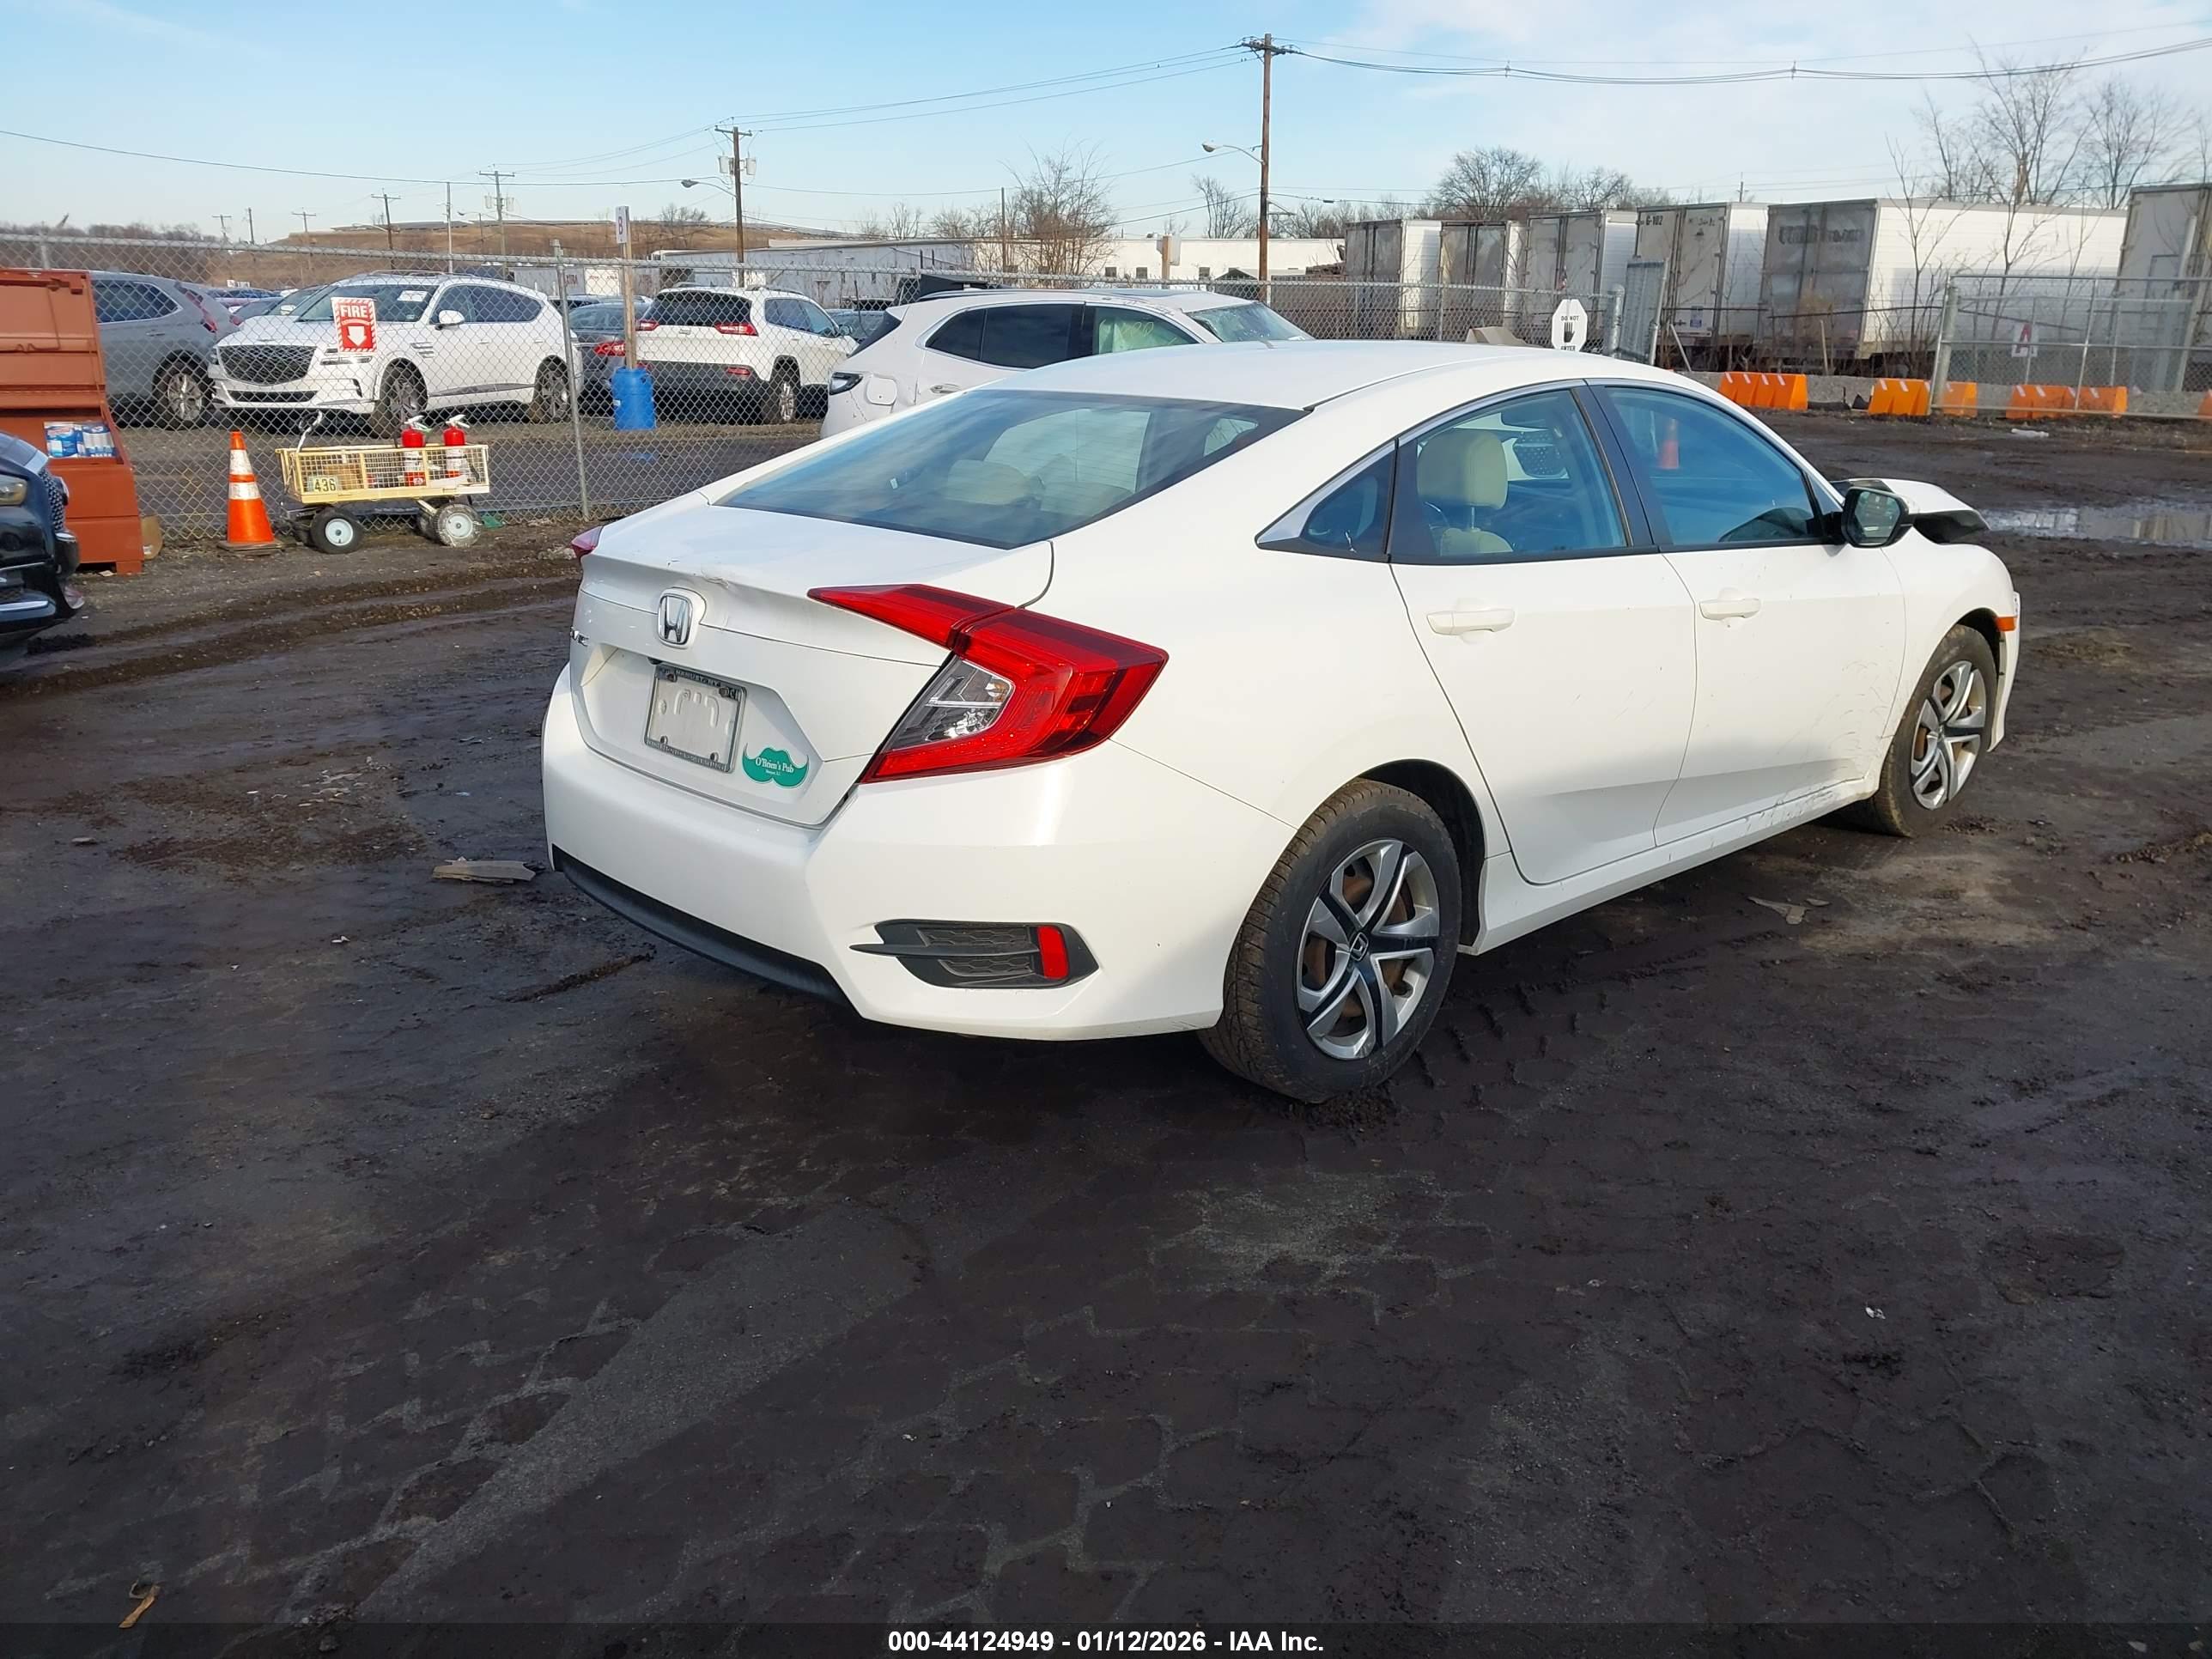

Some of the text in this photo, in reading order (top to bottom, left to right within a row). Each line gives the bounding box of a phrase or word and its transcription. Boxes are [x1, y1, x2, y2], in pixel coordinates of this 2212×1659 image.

[340, 305, 368, 318] FIRE
[314, 478, 336, 492] 436
[756, 757, 781, 771] O'Brien's
[781, 763, 794, 773] Pub
